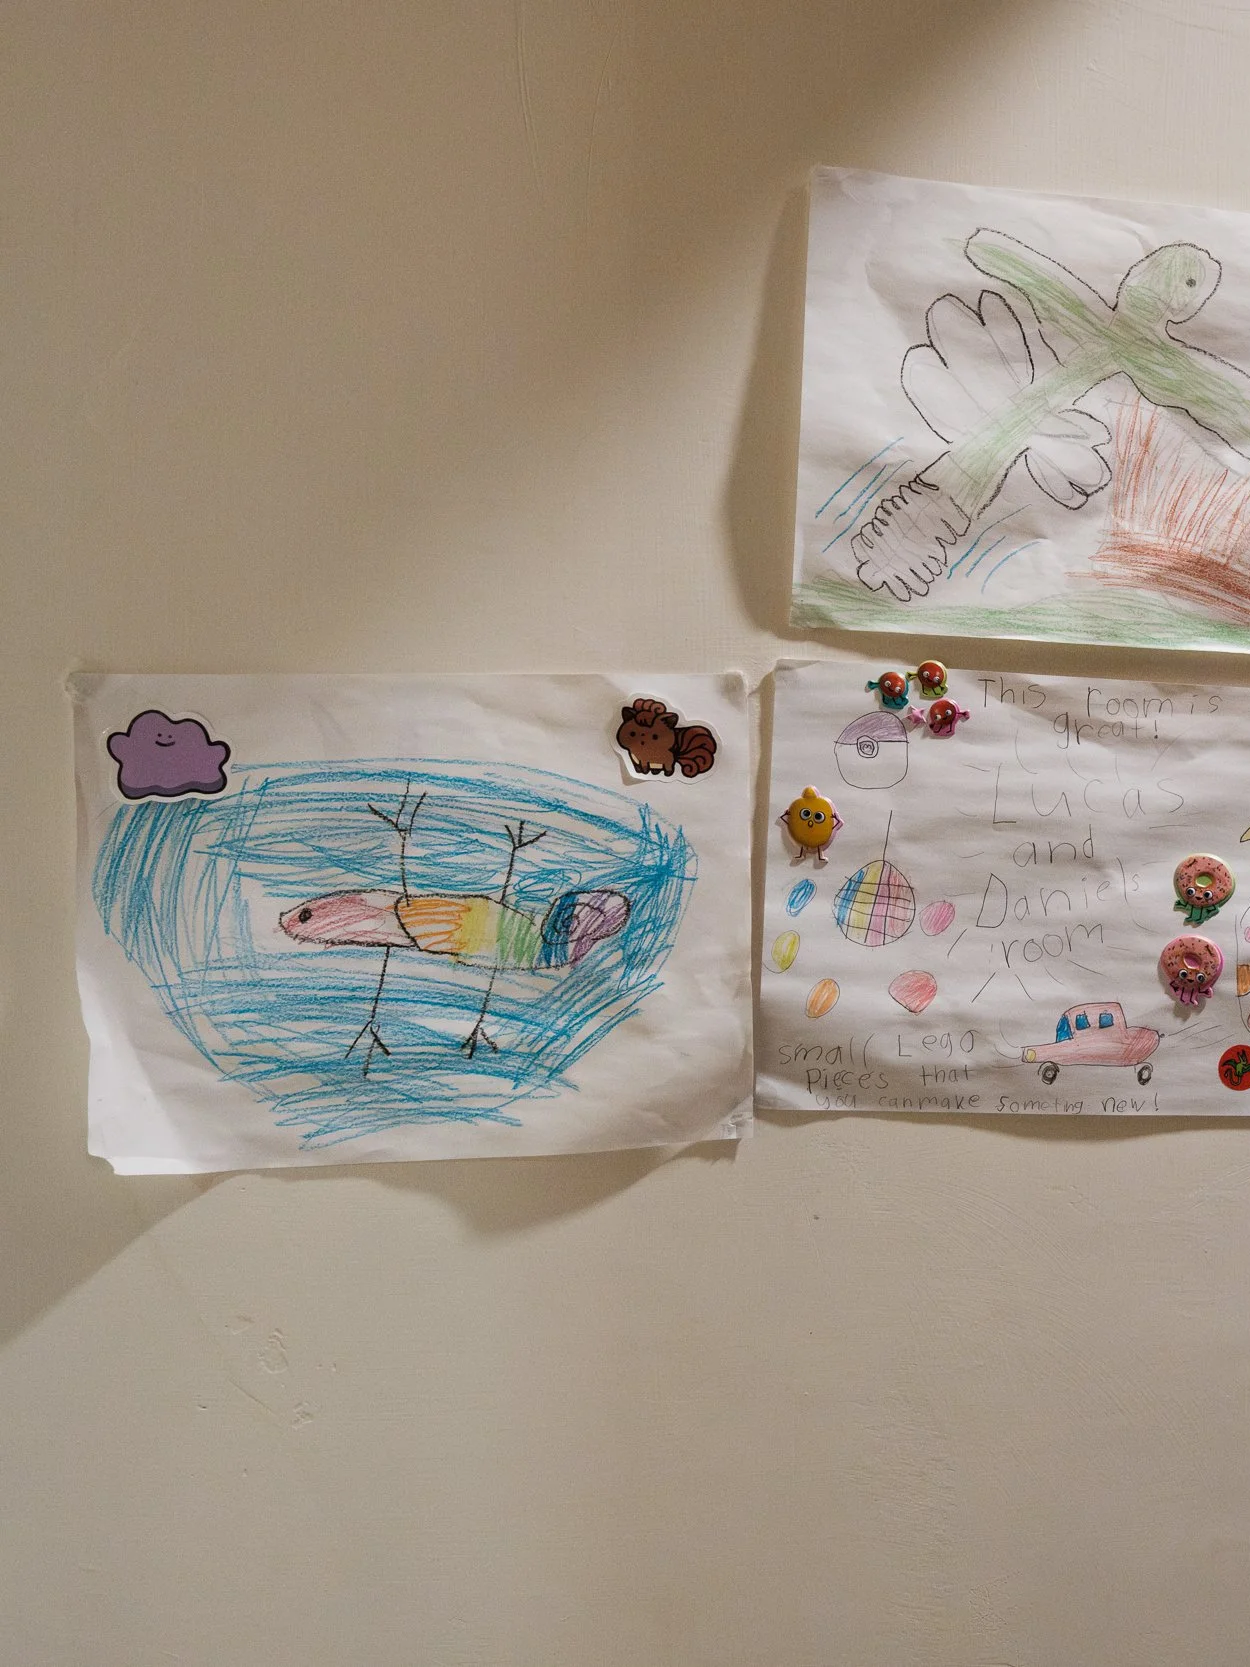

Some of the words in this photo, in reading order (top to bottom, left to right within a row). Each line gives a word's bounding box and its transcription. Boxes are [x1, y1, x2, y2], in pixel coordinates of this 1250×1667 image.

[977, 676, 1047, 709] This
[1086, 686, 1174, 719] room
[1189, 694, 1223, 714] is
[1053, 711, 1160, 750] great!
[992, 762, 1185, 825] Lucas
[1012, 823, 1095, 868] and
[975, 857, 1142, 929] Daniels
[1001, 922, 1104, 969] room
[778, 1032, 876, 1070] small
[897, 1028, 982, 1060] Lego
[918, 1063, 976, 1087] that
[1101, 1092, 1161, 1114] new!
